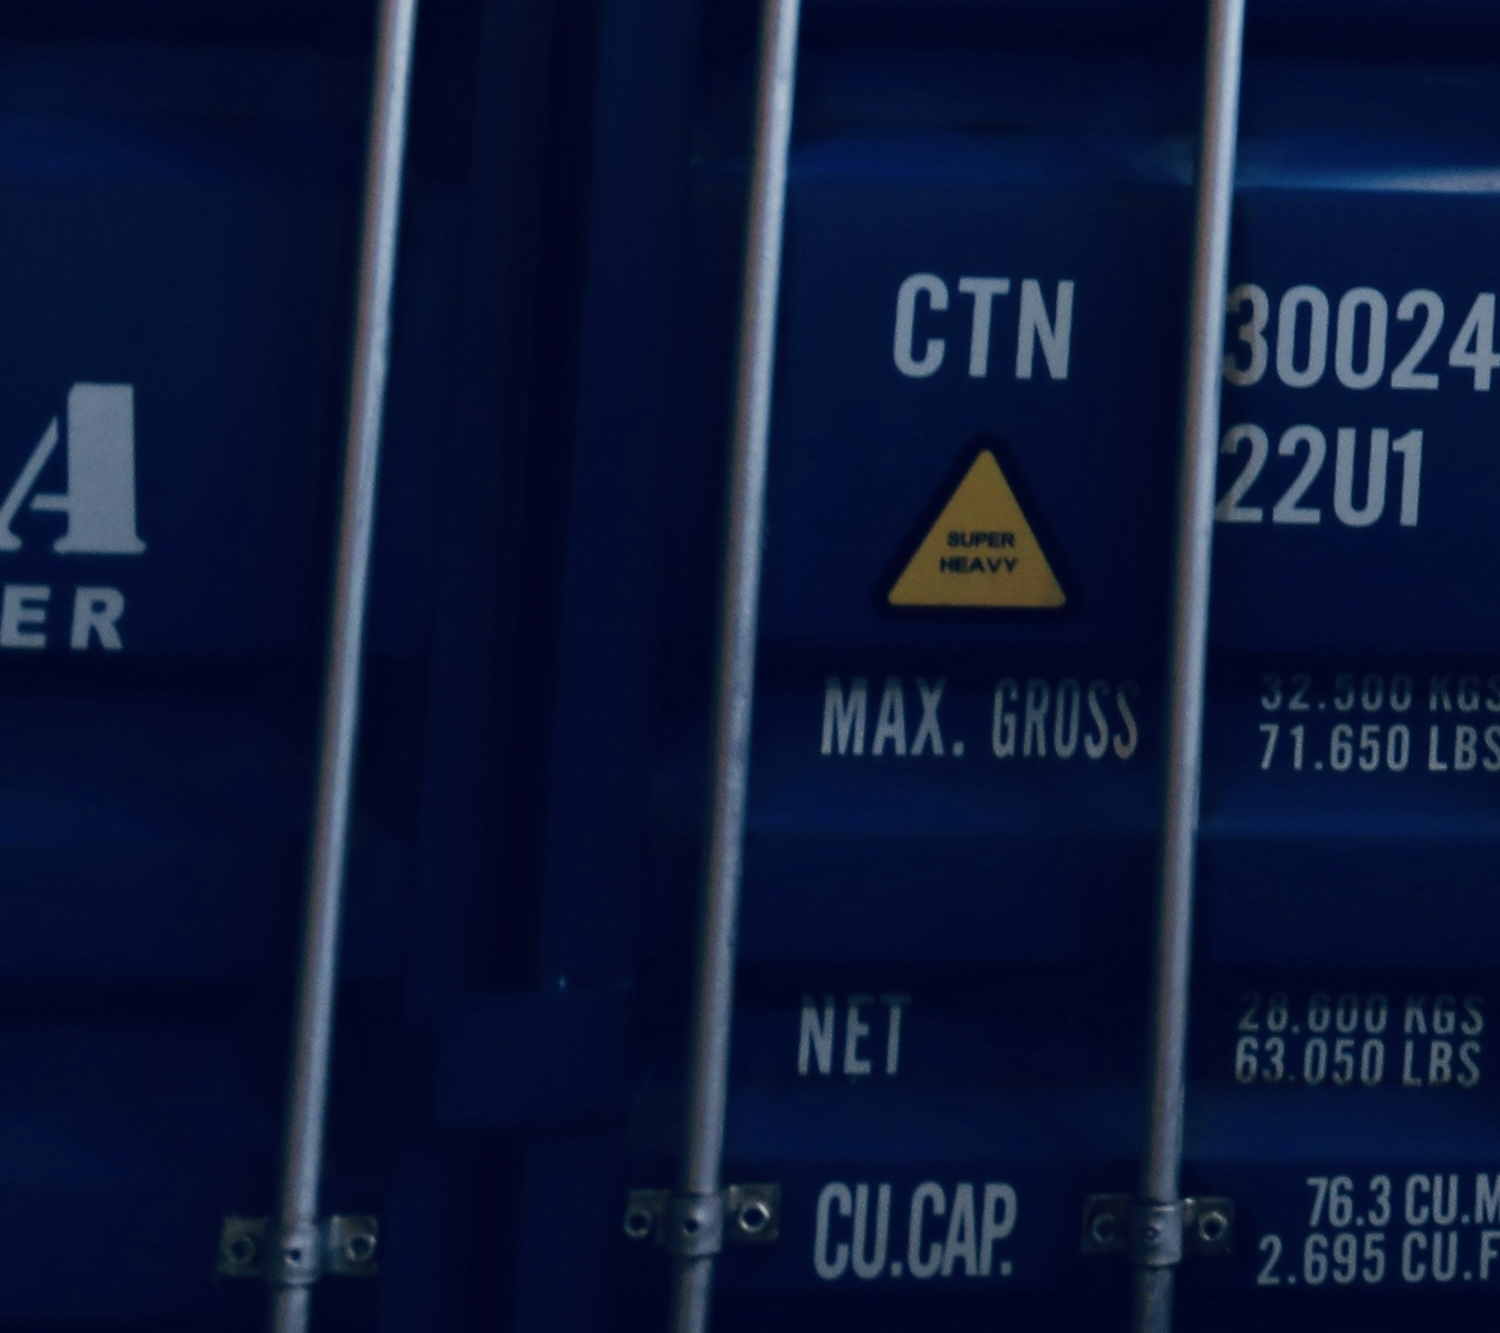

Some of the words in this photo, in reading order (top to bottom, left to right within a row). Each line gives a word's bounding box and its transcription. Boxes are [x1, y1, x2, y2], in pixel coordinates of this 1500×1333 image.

[893, 273, 1075, 381] CTN
[1213, 422, 1424, 529] 22U1
[939, 555, 1018, 574] HEAVY
[946, 530, 1016, 549] SUPER
[820, 676, 965, 758] MAX.
[991, 677, 1141, 760] GROSS
[1259, 672, 1413, 713] 32.500
[1258, 721, 1412, 772] 71.650
[797, 993, 912, 1077] NET
[1236, 990, 1390, 1036] 28.600
[1403, 993, 1485, 1036] KGS
[1234, 1035, 1386, 1087] 63.050
[1402, 1038, 1482, 1089] LBS
[1306, 1173, 1393, 1228] 76.3
[812, 1180, 1019, 1282] CU.CAP.
[1255, 1230, 1387, 1287] 2.695
